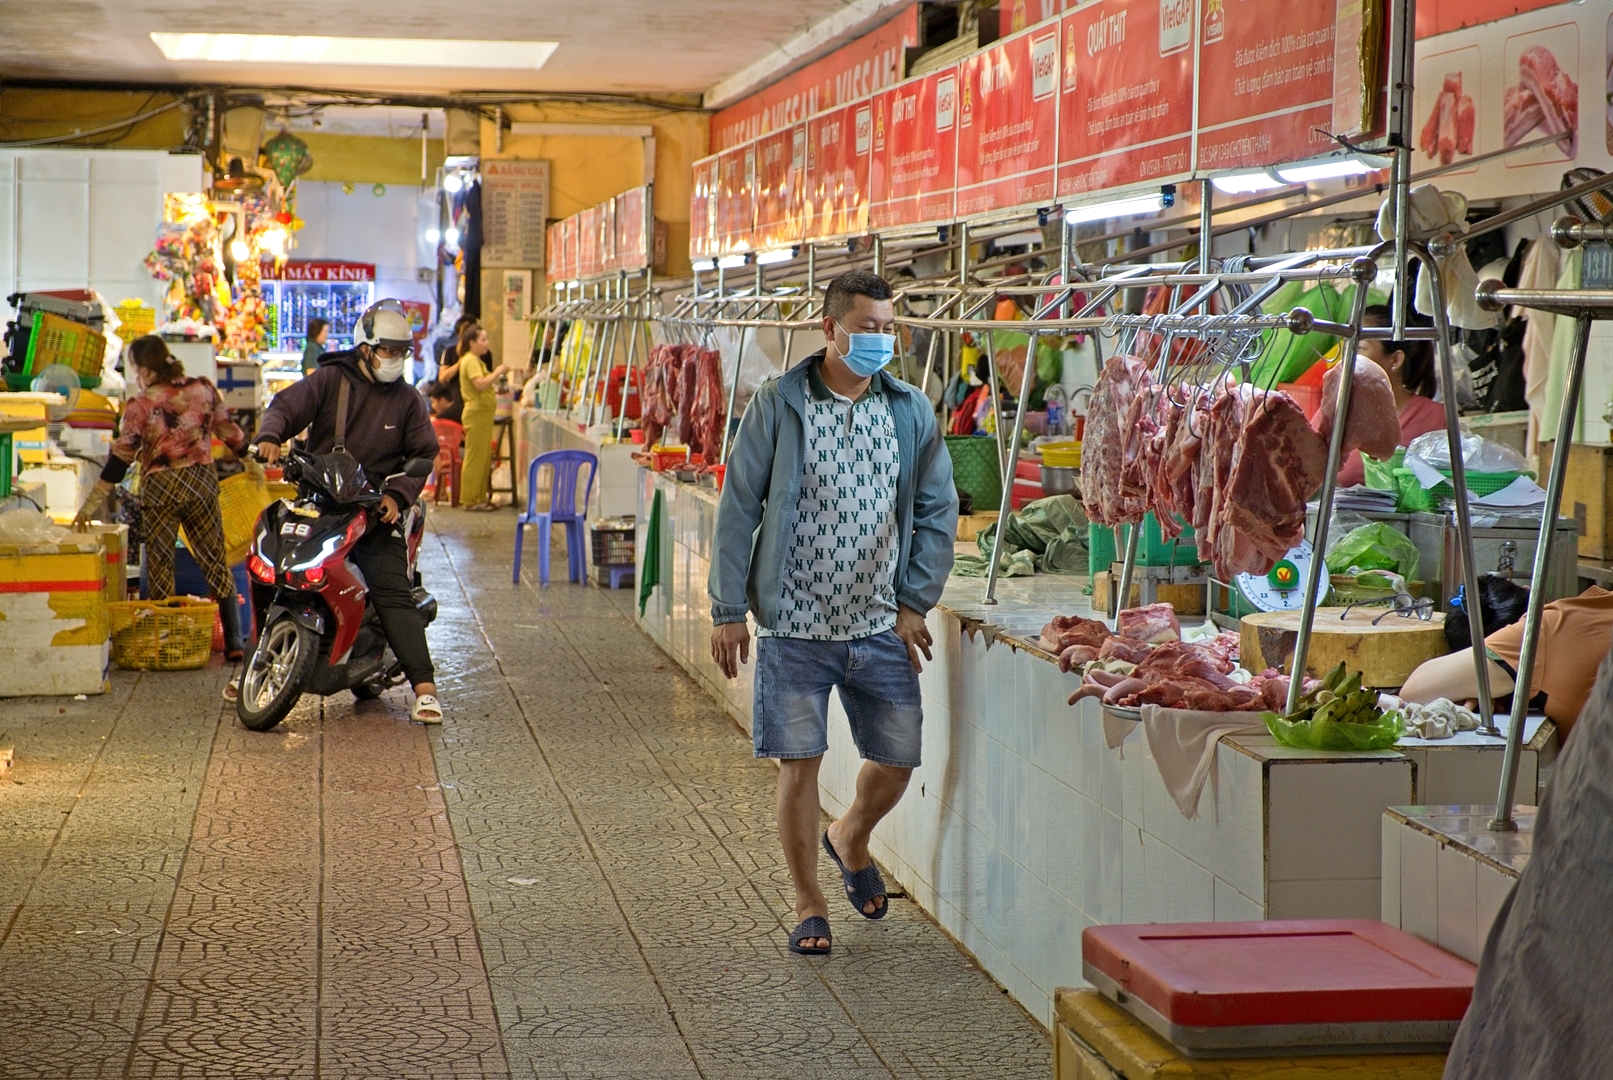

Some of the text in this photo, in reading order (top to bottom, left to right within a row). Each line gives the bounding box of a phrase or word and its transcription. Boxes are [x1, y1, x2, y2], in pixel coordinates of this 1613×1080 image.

[1109, 10, 1127, 52] THỊT
[1207, 22, 1222, 37] VISSAN
[1244, 45, 1255, 67] được
[1269, 41, 1280, 61] dịch
[1282, 35, 1295, 53] 100%
[1315, 28, 1328, 48] quan
[1285, 68, 1292, 84] an
[1313, 55, 1325, 75] sinh
[1251, 131, 1271, 154] THÀNH
[327, 265, 367, 280] KÍNH
